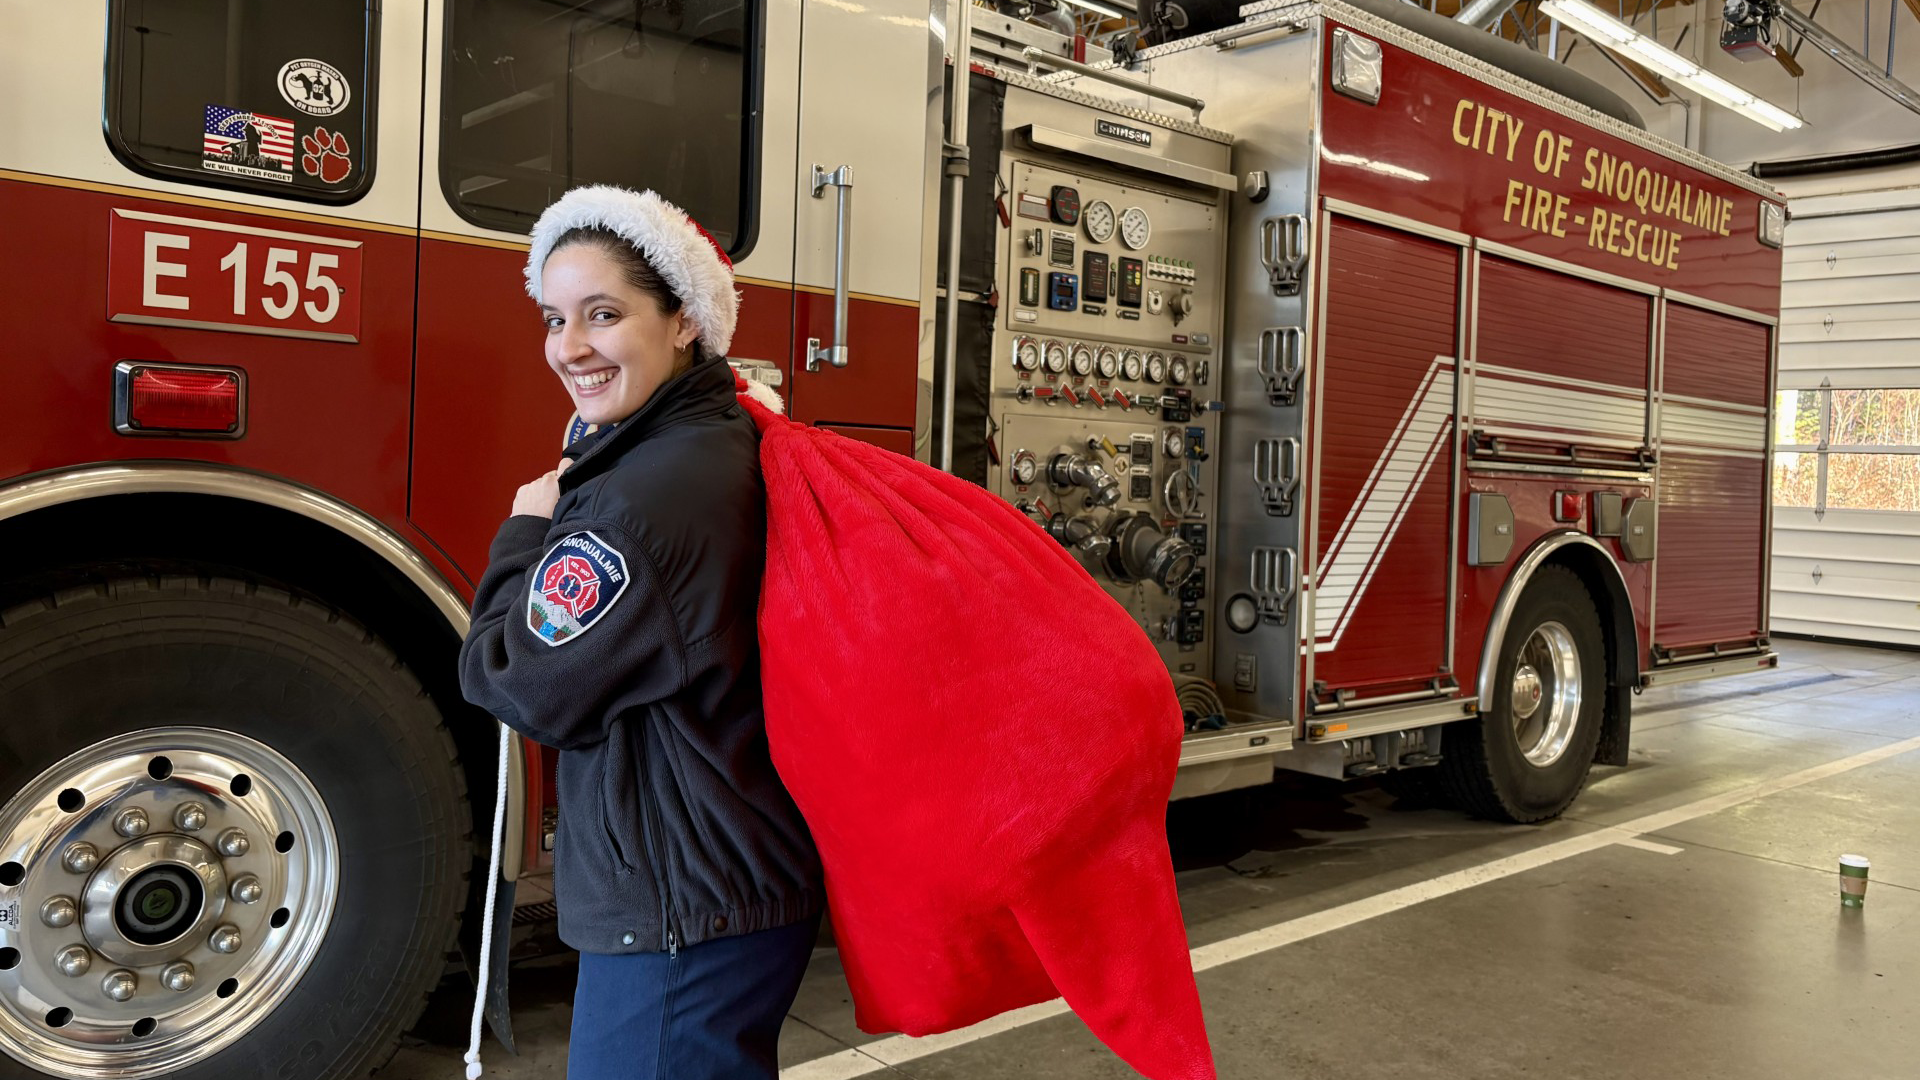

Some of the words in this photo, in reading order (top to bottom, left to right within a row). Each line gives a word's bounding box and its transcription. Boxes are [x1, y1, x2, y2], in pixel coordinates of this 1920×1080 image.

[296, 101, 307, 110] ON
[307, 105, 332, 114] BOARD
[219, 115, 256, 131] SEPTEMBER
[1100, 122, 1150, 143] CRIMSON
[218, 164, 235, 172] WILL
[237, 167, 262, 177] NEVER
[263, 172, 291, 181] FORGET
[1452, 99, 1524, 162] CITY
[1533, 129, 1573, 178] OF
[1581, 147, 1734, 237] SNOQUALMIE
[143, 231, 190, 310] E
[220, 241, 340, 323] 155
[562, 537, 623, 583] SNOQUALMIE
